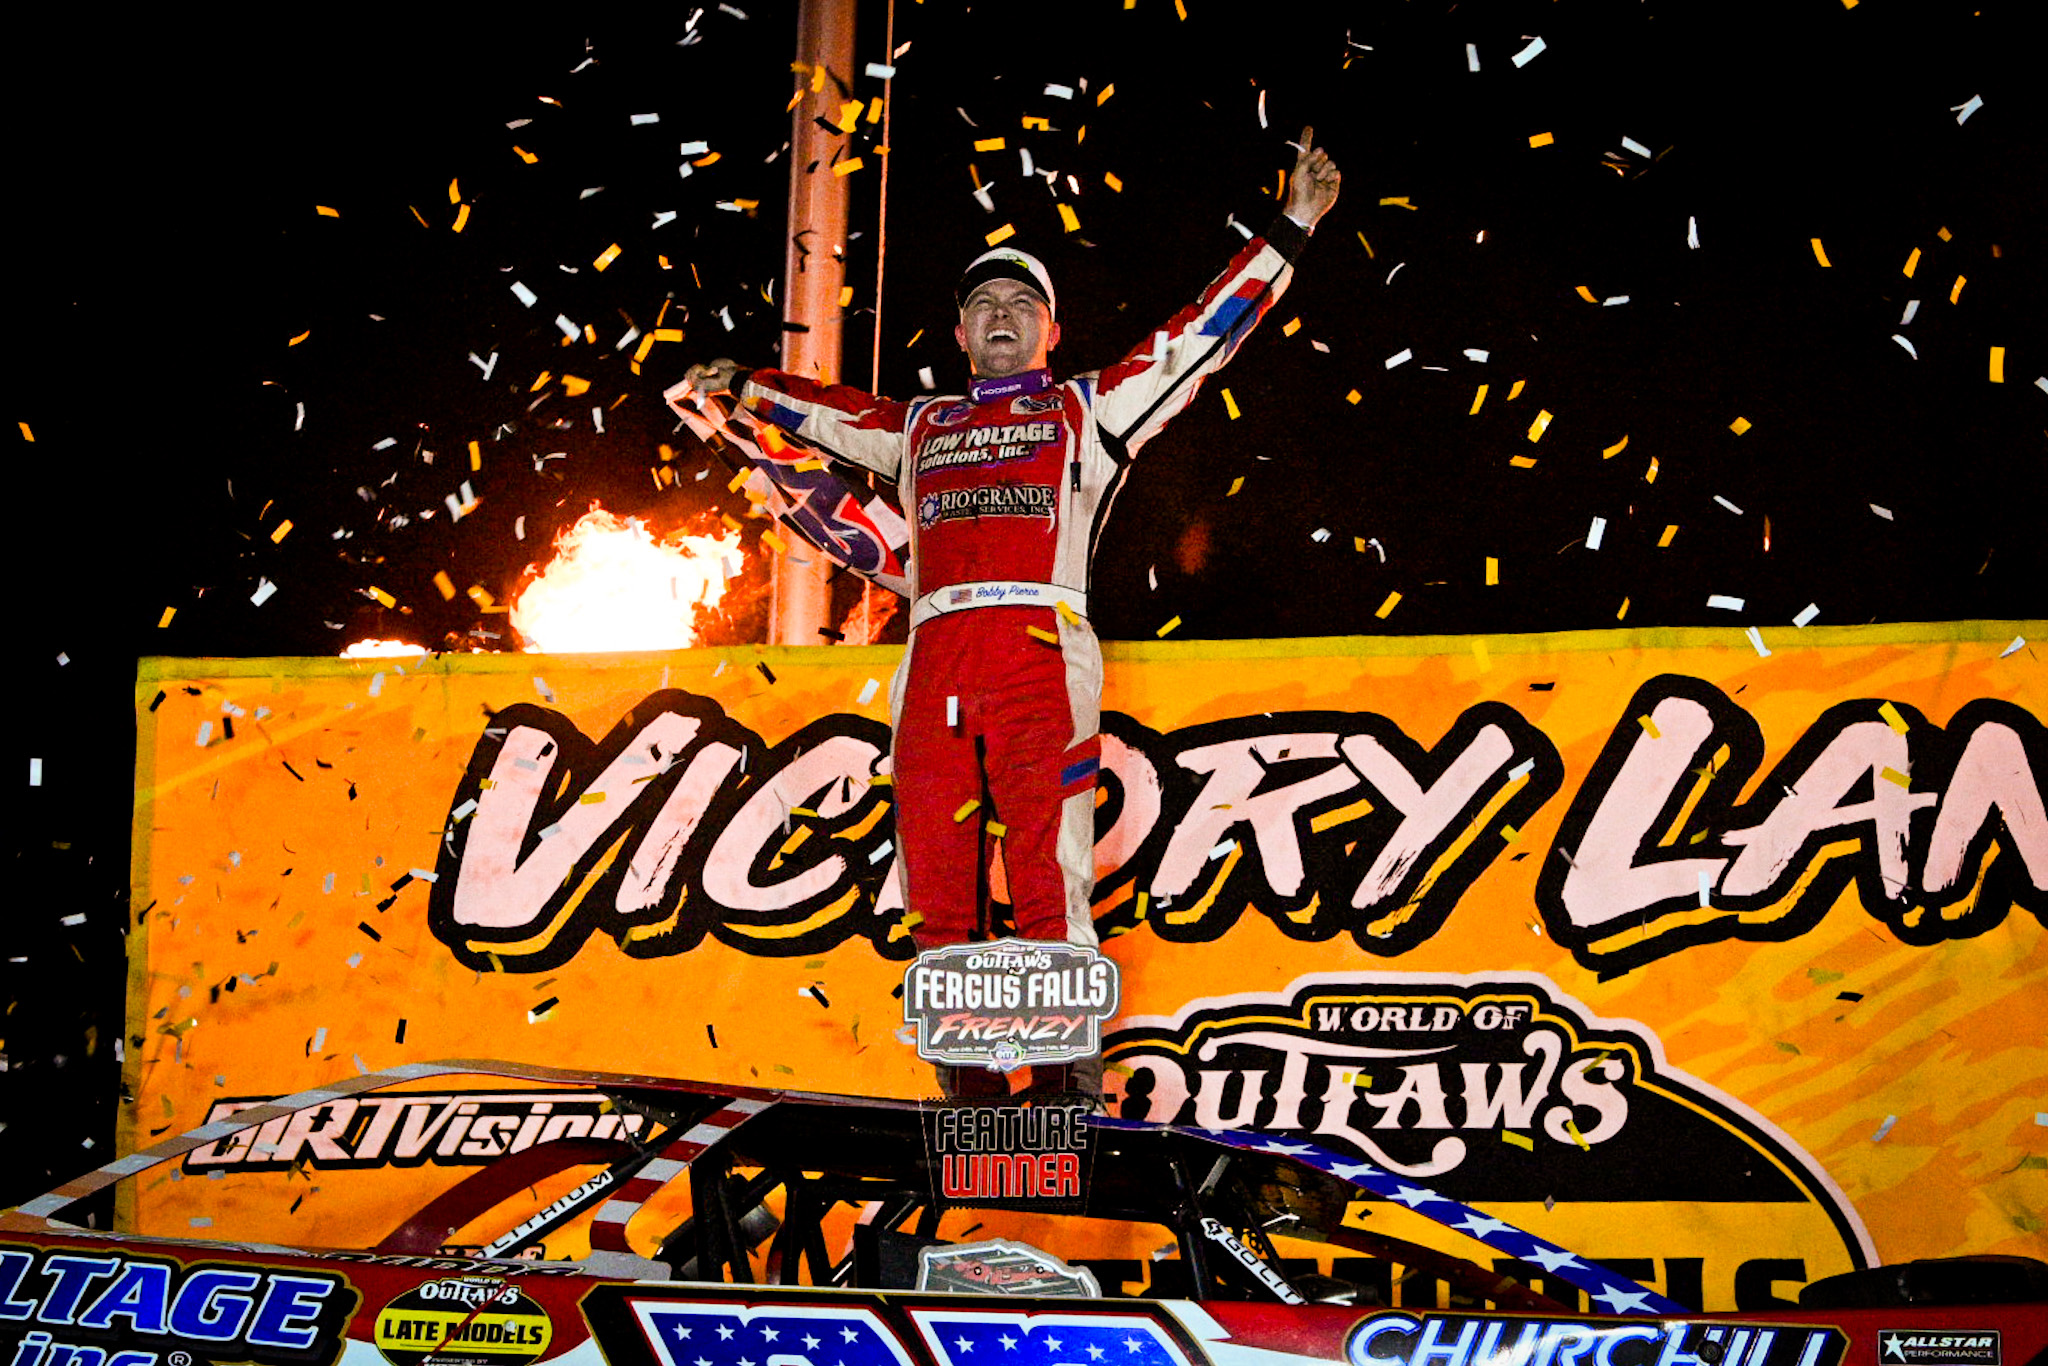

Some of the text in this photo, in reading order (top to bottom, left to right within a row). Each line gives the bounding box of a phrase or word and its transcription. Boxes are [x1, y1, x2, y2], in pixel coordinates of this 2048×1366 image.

[922, 423, 1056, 457] LOW VOLTAGE
[941, 486, 1054, 511] RIO GRANDE
[976, 584, 1040, 601] Bobby Pierce
[450, 706, 1516, 932] VICRY
[915, 963, 1108, 1010] FERGUS FALLS
[930, 1012, 1086, 1046] FRENZY
[1317, 1004, 1530, 1032] WORLD OF
[1101, 1028, 1628, 1178] OUTLAWS
[936, 1106, 1089, 1153] FEATURE
[942, 1152, 1081, 1199] WINNER
[491, 1170, 610, 1249] LITHIUM
[1225, 1236, 1258, 1265] GO
[383, 1319, 543, 1345] LATE MODELS
[1903, 1337, 1992, 1348] ALLSTAR
[1904, 1350, 1994, 1358] PERFORMANCE
